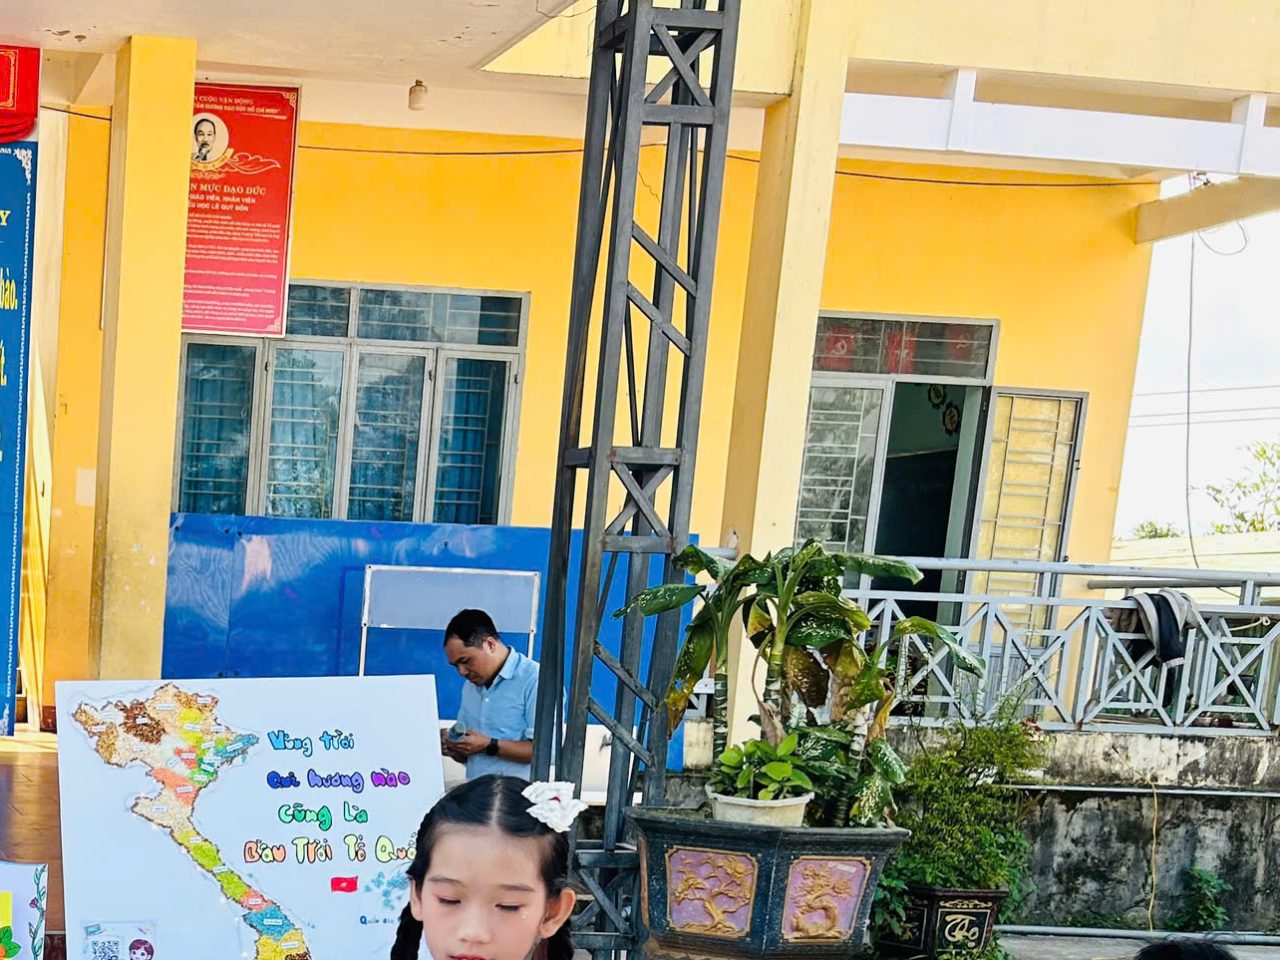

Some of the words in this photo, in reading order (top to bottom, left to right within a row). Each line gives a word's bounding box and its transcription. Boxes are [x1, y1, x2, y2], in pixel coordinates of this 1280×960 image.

[0, 267, 18, 310] bào.
[267, 730, 313, 757] Vùng
[371, 768, 410, 788] nào
[278, 802, 332, 831] Cũng
[343, 801, 368, 823] Là
[243, 838, 286, 863] Bầu
[292, 836, 333, 864] Trời
[344, 833, 366, 862] Tổ
[375, 832, 418, 863] Quố
